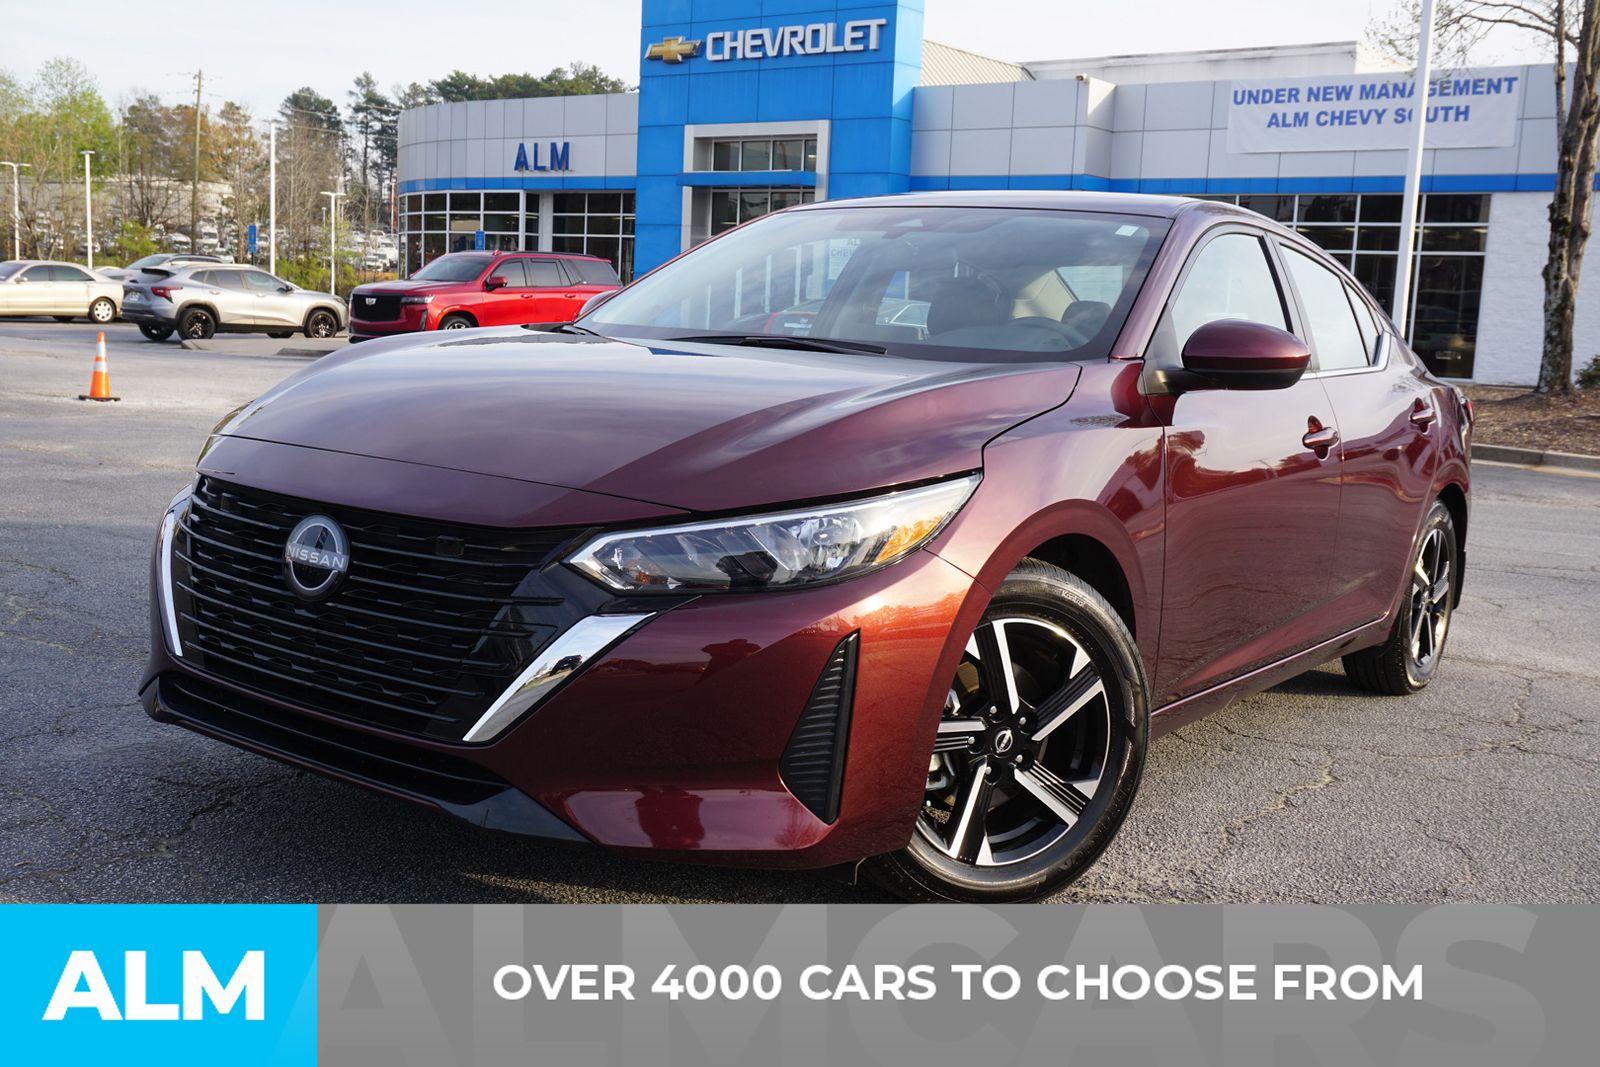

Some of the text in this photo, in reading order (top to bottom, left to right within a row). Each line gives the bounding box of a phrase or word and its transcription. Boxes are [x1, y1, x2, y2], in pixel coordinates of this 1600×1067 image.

[705, 17, 887, 62] CHEVROLET
[1233, 87, 1301, 105] UNDER
[1306, 85, 1354, 102] NEW
[1266, 111, 1309, 128] ALM
[1315, 108, 1388, 127] CHEVY
[513, 141, 571, 171] ALM
[287, 545, 344, 568] NISSAN
